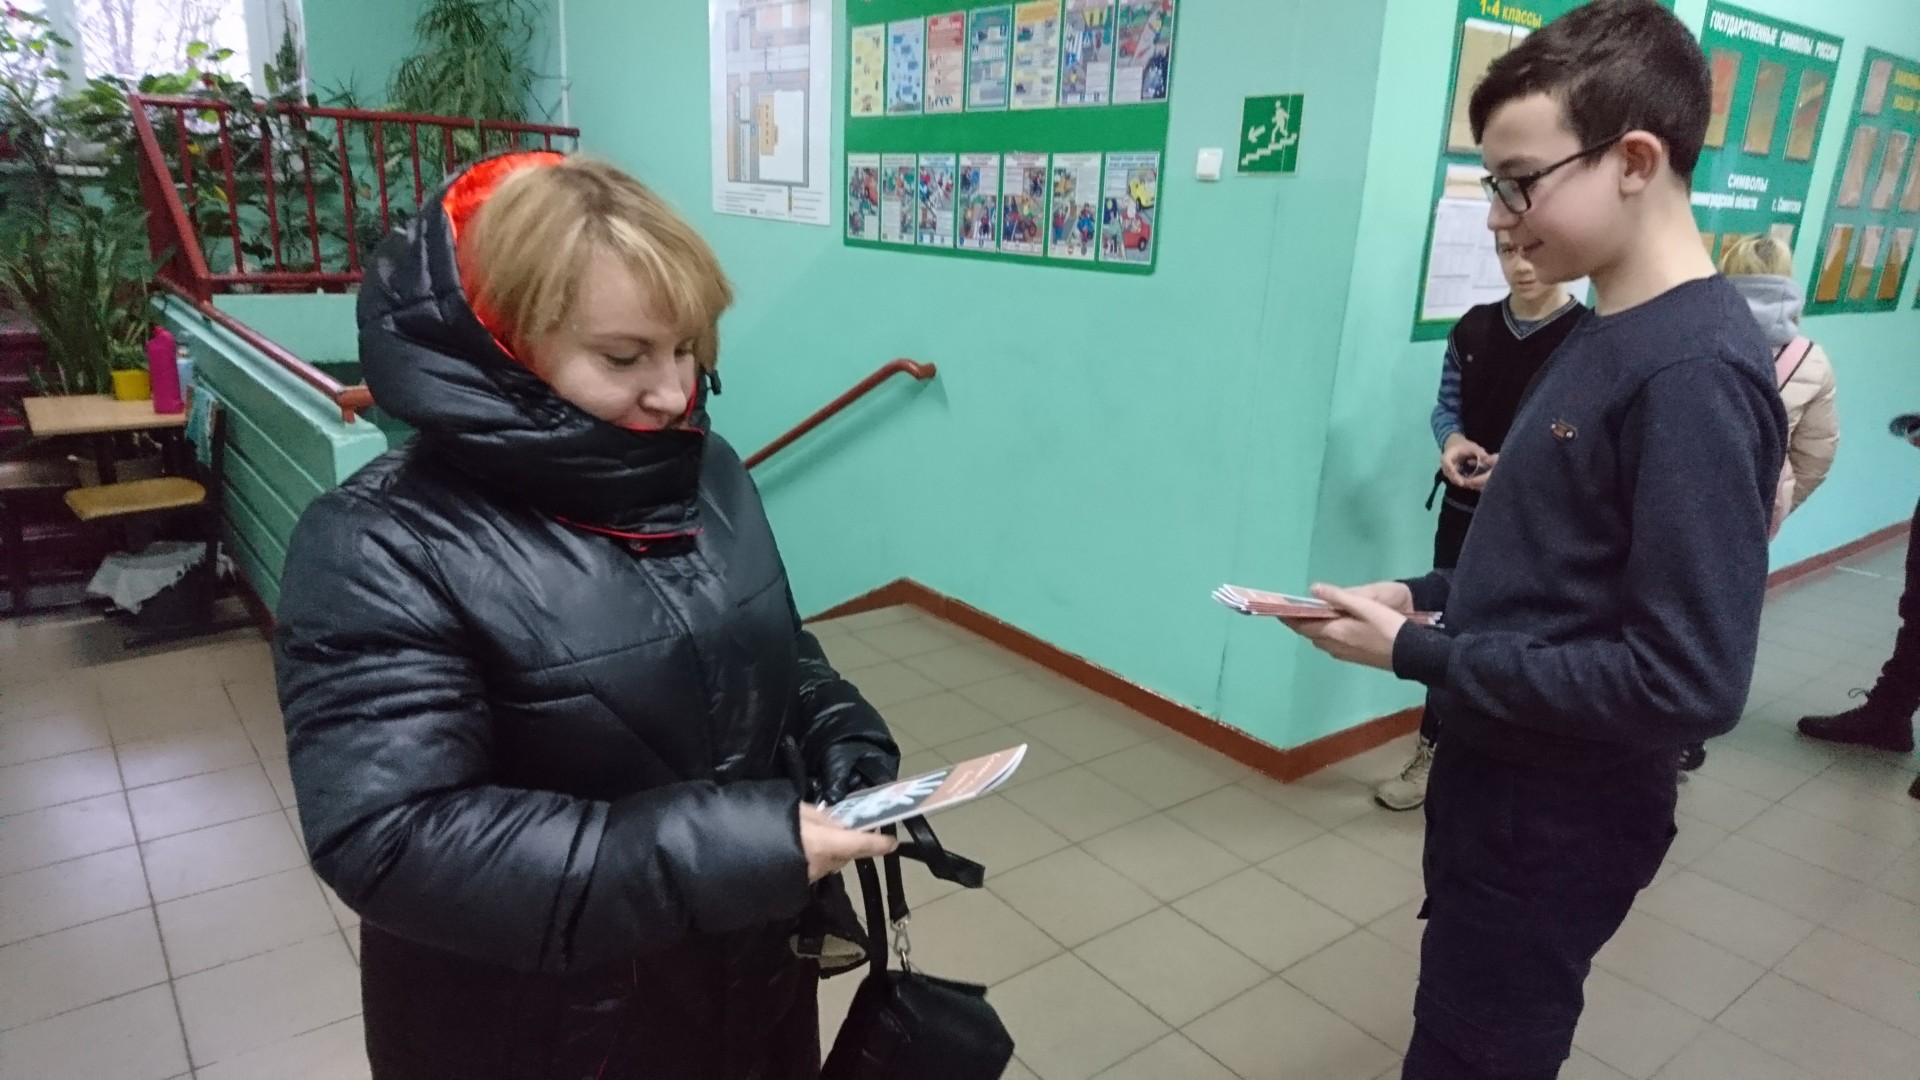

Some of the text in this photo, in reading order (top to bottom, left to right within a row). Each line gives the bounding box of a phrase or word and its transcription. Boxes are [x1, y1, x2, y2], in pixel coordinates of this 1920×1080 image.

[1480, 0, 1542, 29] 1-4 классы
[1709, 10, 1779, 47] ГОСУДАРСТВЕННЫЕ
[1779, 30, 1814, 56] СИМВОЛЫ
[1727, 173, 1769, 193] СИМВОЛЫ
